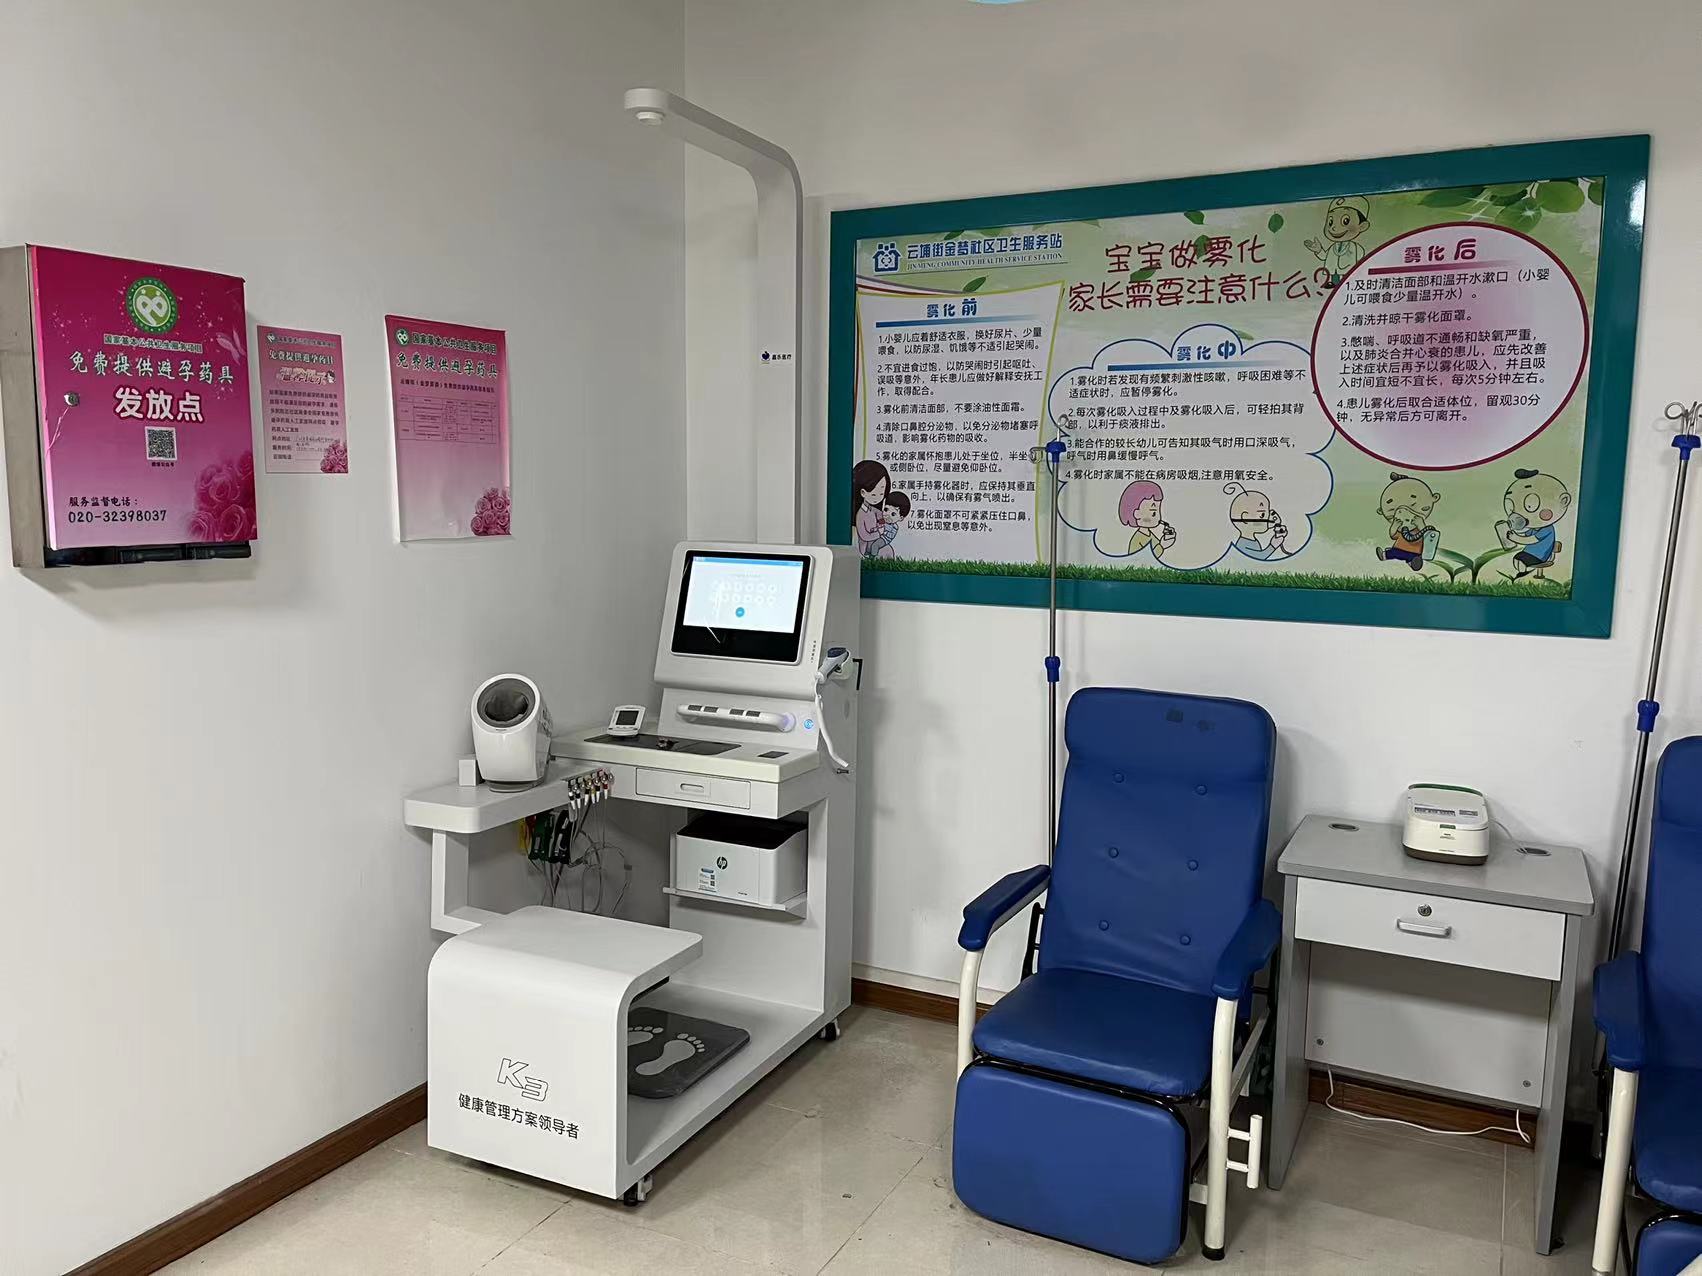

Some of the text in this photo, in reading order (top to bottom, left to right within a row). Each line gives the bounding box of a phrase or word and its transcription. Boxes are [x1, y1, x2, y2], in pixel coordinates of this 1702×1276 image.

[907, 233, 1063, 259] 云埔街金梦社区卫生服务站
[1105, 234, 1267, 273] 宝宝做雾化
[1404, 238, 1477, 263] 雾化后
[907, 252, 1063, 271] JINMENG COMMUNITY HEALTH SERVICE STATION
[1345, 268, 1550, 291] 1.及时清洁面部和温开水漱口（小婴
[1068, 267, 1331, 312] 家长需要注意什么？
[1343, 287, 1479, 306] 儿可喂食少量温开水）。
[926, 298, 978, 318] 雾化前
[1342, 308, 1473, 327] 2.清洗并晾干雾化面罩。
[878, 327, 1043, 344] 1.小婴儿应着舒适衣服，换好尿片、少量
[877, 339, 1041, 355] 喂食，以防尿湿、饥饿等不适引起哭闹。
[1176, 340, 1237, 362] 雾化中
[1340, 342, 1548, 360] 以及肺炎合并心衰的患儿，应先改善
[69, 351, 234, 385] 免费提供避孕药具
[397, 352, 498, 379] 免费提供避孕药具
[877, 358, 1039, 373] 2.不宜进食过饱，以防哭闹时引起呕吐、
[1339, 357, 1546, 375] 上述症状后再予以雾化吸入，并且吸
[877, 370, 1043, 385] 误吸等意外，年长患儿应做好解释安抚工
[1070, 369, 1307, 387] 1.雾化时若发现有频繁刺激性咳嗽，呼吸困难等不
[1338, 373, 1546, 389] 入时间宜短不宜长，每次5分钟左右。
[877, 386, 935, 397] 作，取得配合。
[1069, 386, 1180, 399] 适症状时，应暂停雾化。
[113, 387, 205, 423] 发放点
[876, 402, 1026, 414] 3.雾化前清洁面部，不要涂油性面霜。
[1068, 403, 1304, 417] 2.每次雾化吸入过程中及雾化吸入后，可轻拍其背
[1336, 394, 1541, 410] 4.患儿雾化后取合适体位，留观30分
[1336, 409, 1469, 423] 钟，无异常后方可离开。
[876, 420, 1039, 432] 4.清除口鼻腔分泌物，以免分泌物堵塞呼
[876, 432, 989, 443] 吸道，影响雾化药物的吸收。
[1067, 437, 1297, 450] 3.能合作的较长幼儿可告知其吸气时用口深吸气，
[1066, 450, 1166, 462] 呼气时用鼻缓慢呼气。
[889, 463, 1003, 473] 或侧卧位，尽量避免仰卧位。
[891, 480, 1035, 492] 6.家属手持雾化器时，应保持其垂直
[68, 496, 139, 507] 服务监督电话：
[910, 492, 1016, 503] 向上，以确保有雾气喷出。
[68, 509, 167, 524] 020-32398037
[910, 510, 1032, 522] 7.雾化面罩不可紧紧压住口鼻，
[907, 521, 994, 532] 以免出现窒息等意外。
[716, 856, 728, 870] hp
[497, 1057, 549, 1102] K3
[458, 1093, 580, 1139] 健康管理方案领导者
